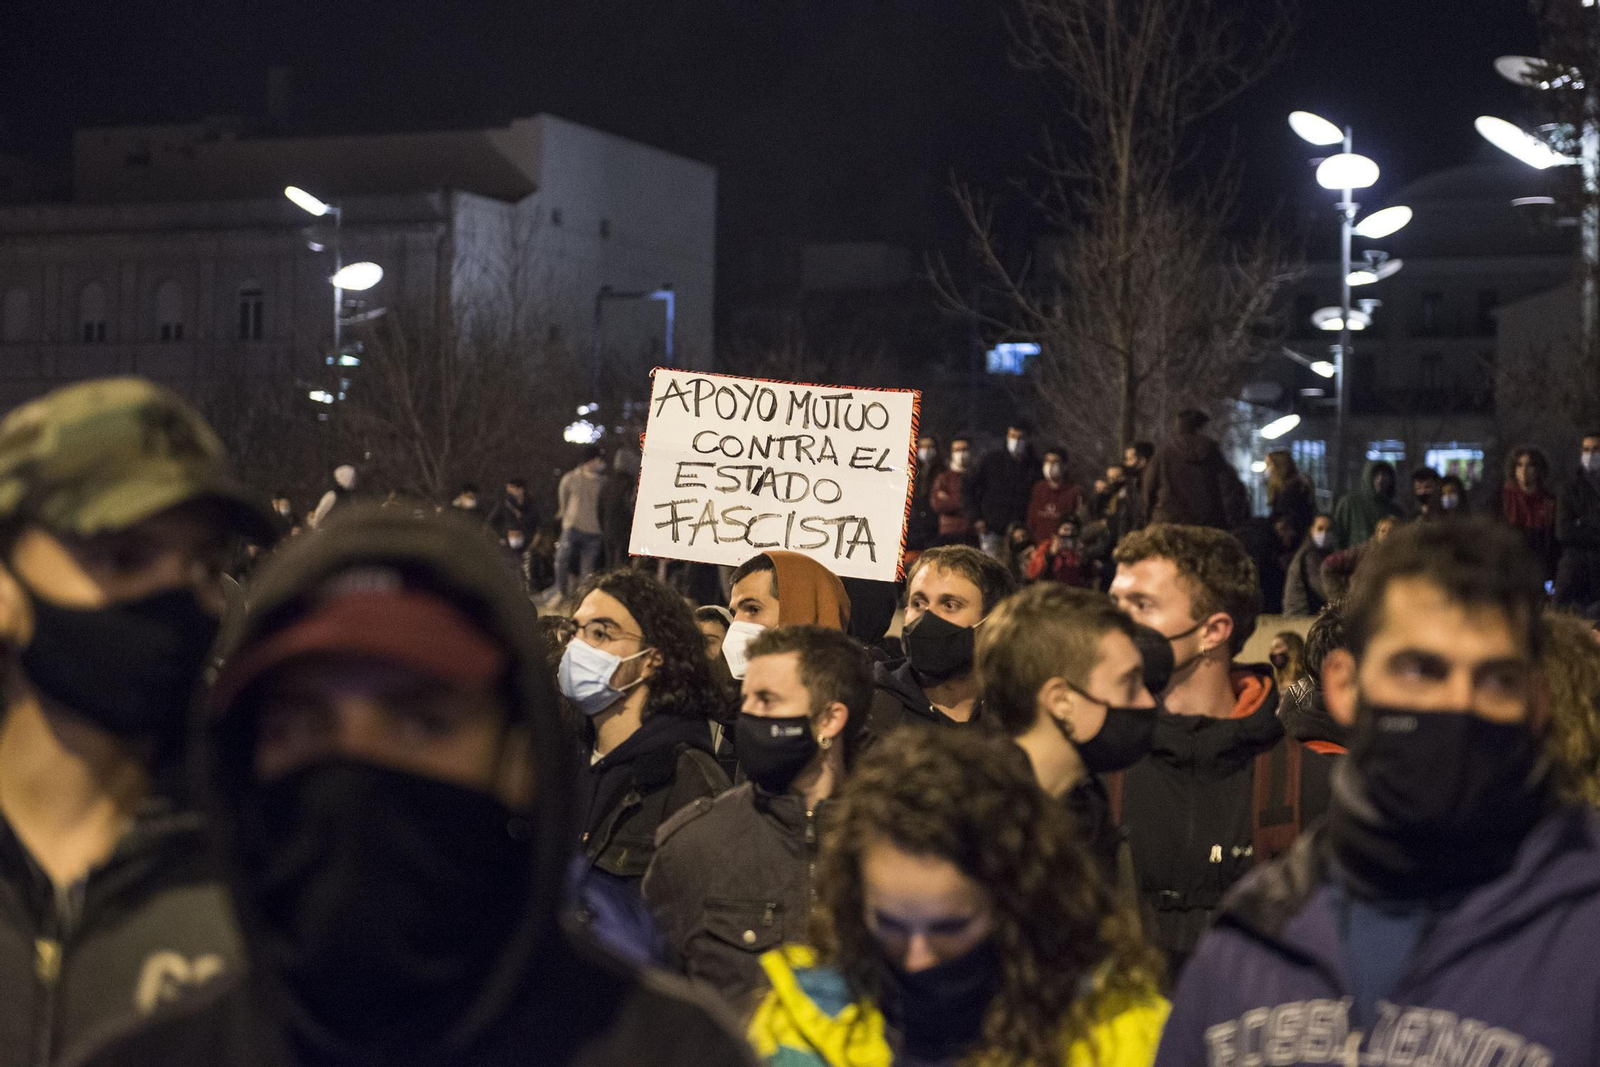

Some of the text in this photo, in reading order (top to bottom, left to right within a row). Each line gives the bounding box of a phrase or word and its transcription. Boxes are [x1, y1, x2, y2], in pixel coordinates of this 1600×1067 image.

[655, 378, 889, 432] APOYO MUTUO
[692, 430, 894, 472] CONTRA EL
[674, 461, 843, 504] ESTADO
[653, 498, 877, 563] FASCISTA
